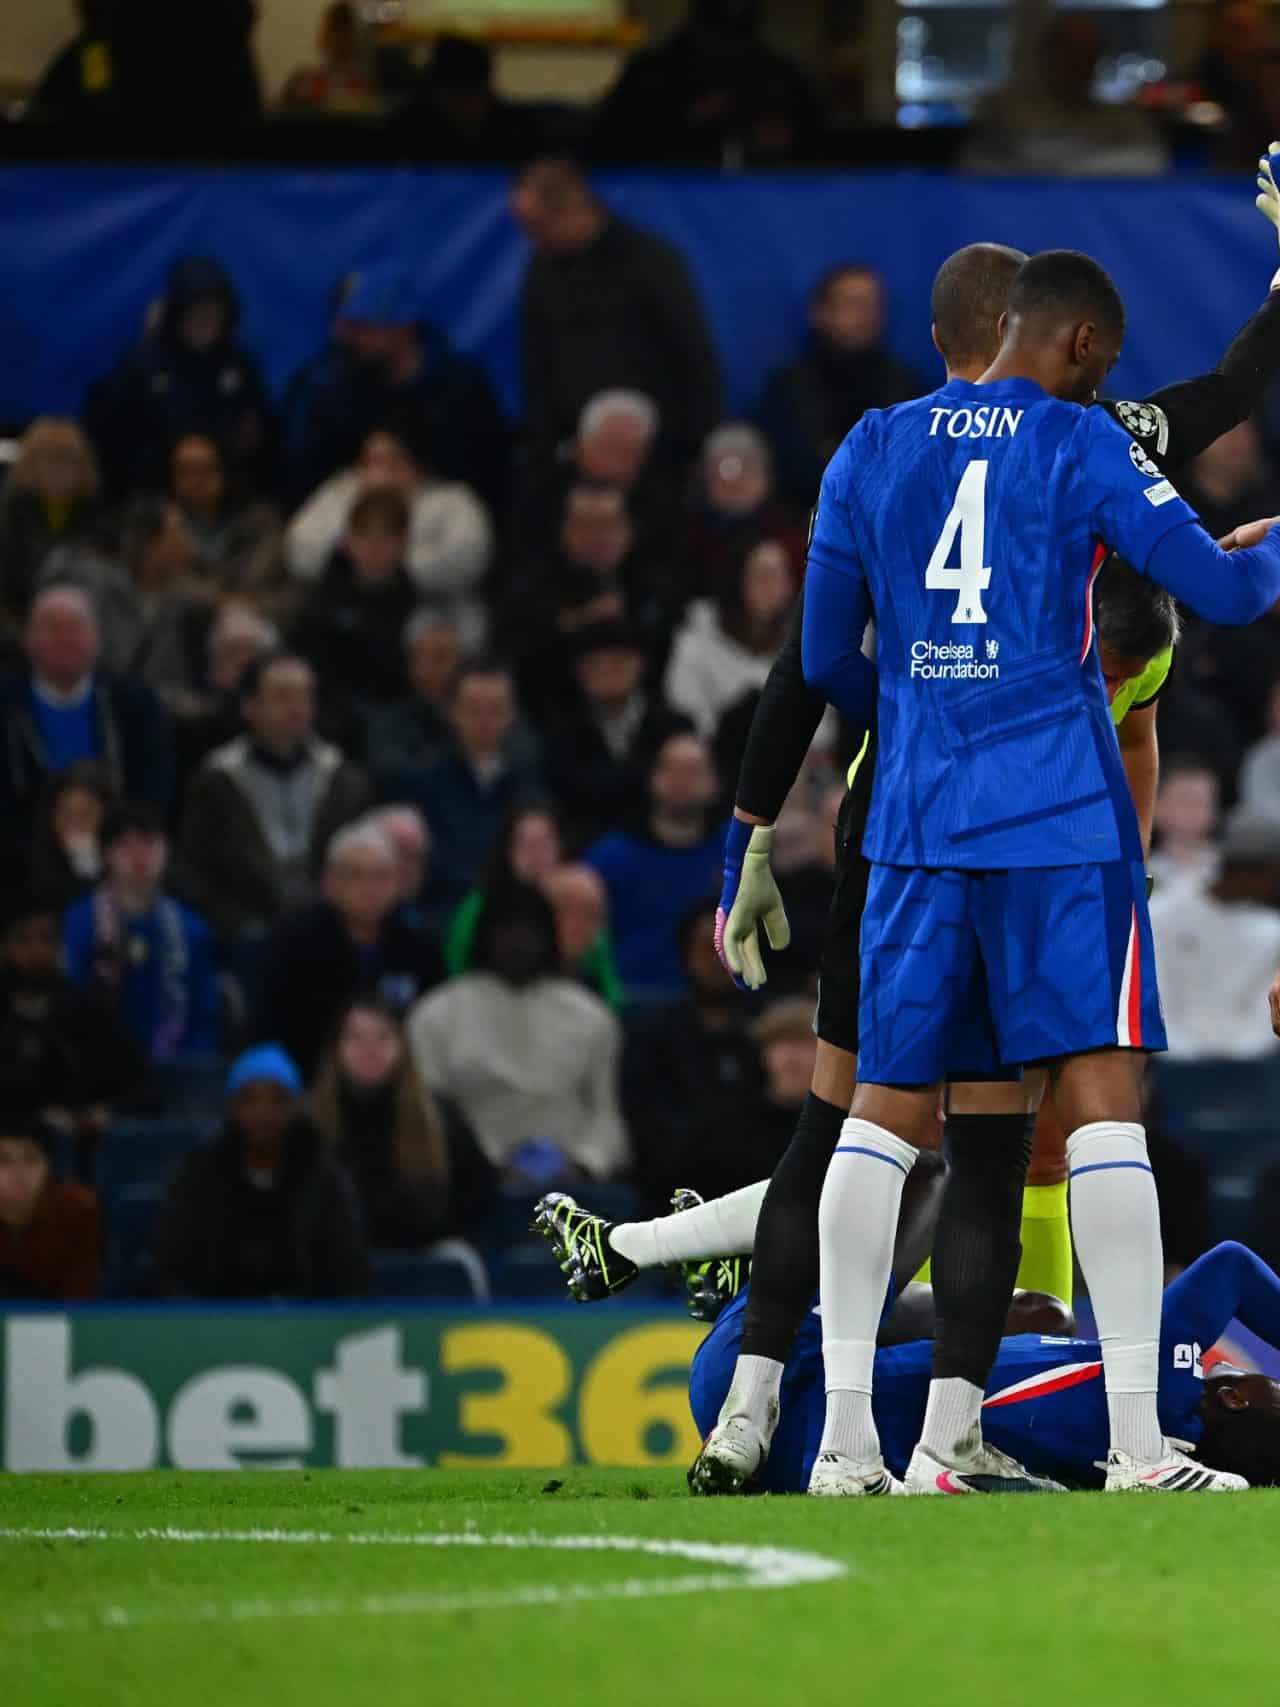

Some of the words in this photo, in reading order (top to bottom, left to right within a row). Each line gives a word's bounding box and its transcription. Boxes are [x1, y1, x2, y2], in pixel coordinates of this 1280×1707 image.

[929, 407, 1023, 438] TOSIN
[925, 460, 992, 623] 4
[911, 640, 974, 660] Chelsea
[911, 660, 999, 679] Foundation
